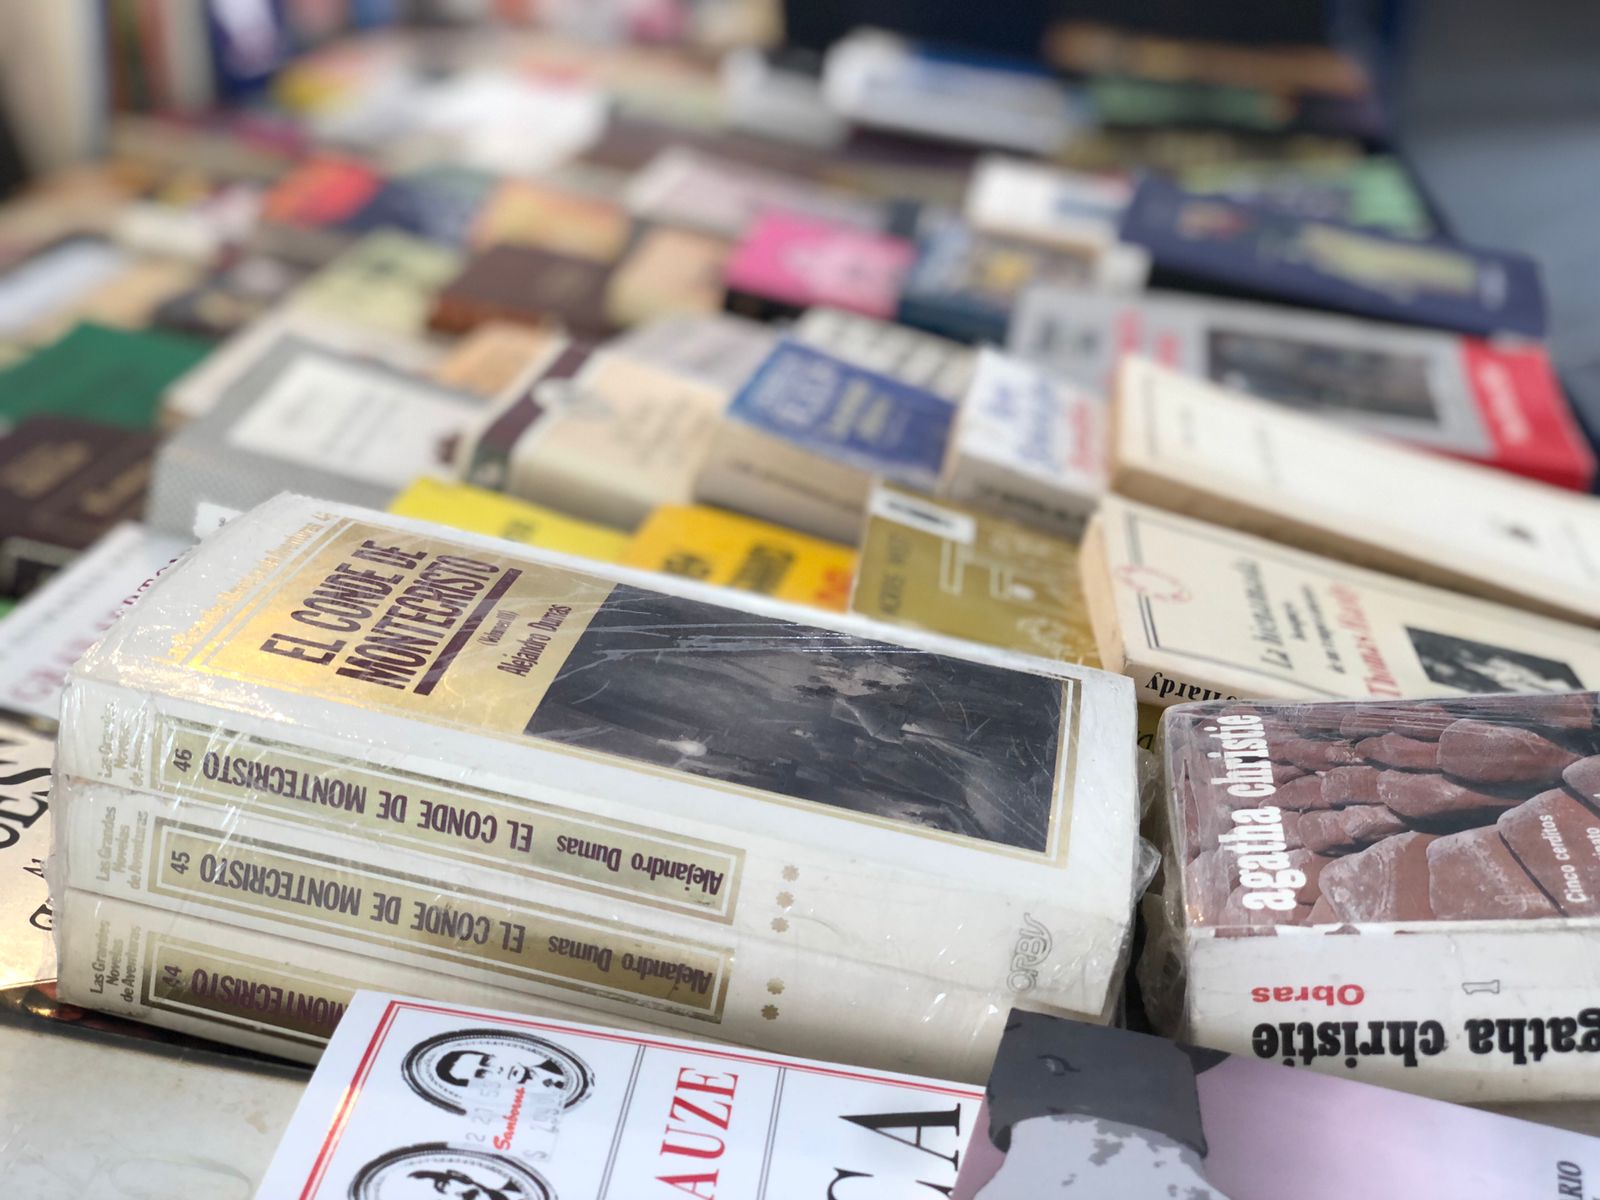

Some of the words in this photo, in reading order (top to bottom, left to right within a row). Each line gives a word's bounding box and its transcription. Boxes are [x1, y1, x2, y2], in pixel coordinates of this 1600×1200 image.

[352, 540, 428, 569] DE
[291, 563, 405, 632] CONDE
[336, 554, 500, 690] MONTECRISTO
[497, 633, 551, 677] Alejandro
[527, 604, 572, 632] Dumas
[259, 633, 347, 665] EL
[173, 748, 193, 773] 46
[1203, 714, 1277, 798] christie
[203, 752, 368, 814] MONTECRISTO
[376, 790, 408, 823] DE
[417, 800, 497, 844] CONDE
[97, 806, 117, 860] Grandes
[112, 825, 130, 873] Novelas
[128, 811, 149, 874] Aventuras
[506, 820, 534, 852] EL
[556, 835, 622, 872] Dumas
[1539, 814, 1570, 861] cerditos
[96, 861, 111, 881] Las
[171, 850, 190, 874] 45
[631, 853, 724, 895] Alejandro
[1218, 806, 1307, 911] agatha
[127, 875, 141, 890] de
[200, 854, 362, 916] MONTECRISTO
[1561, 864, 1588, 902] Cinco
[370, 893, 402, 924] DE
[411, 902, 490, 945] CONDE
[91, 920, 110, 971] Grandes
[121, 926, 141, 988] Aventuras
[499, 922, 526, 953] EL
[548, 936, 612, 972] Dumas
[106, 939, 123, 986] Novelas
[162, 965, 183, 988] 44
[622, 953, 712, 994] Alejandro
[90, 973, 104, 994] Las
[120, 987, 133, 1003] de
[1250, 983, 1365, 1006] Obras
[1252, 1019, 1446, 1070] christie
